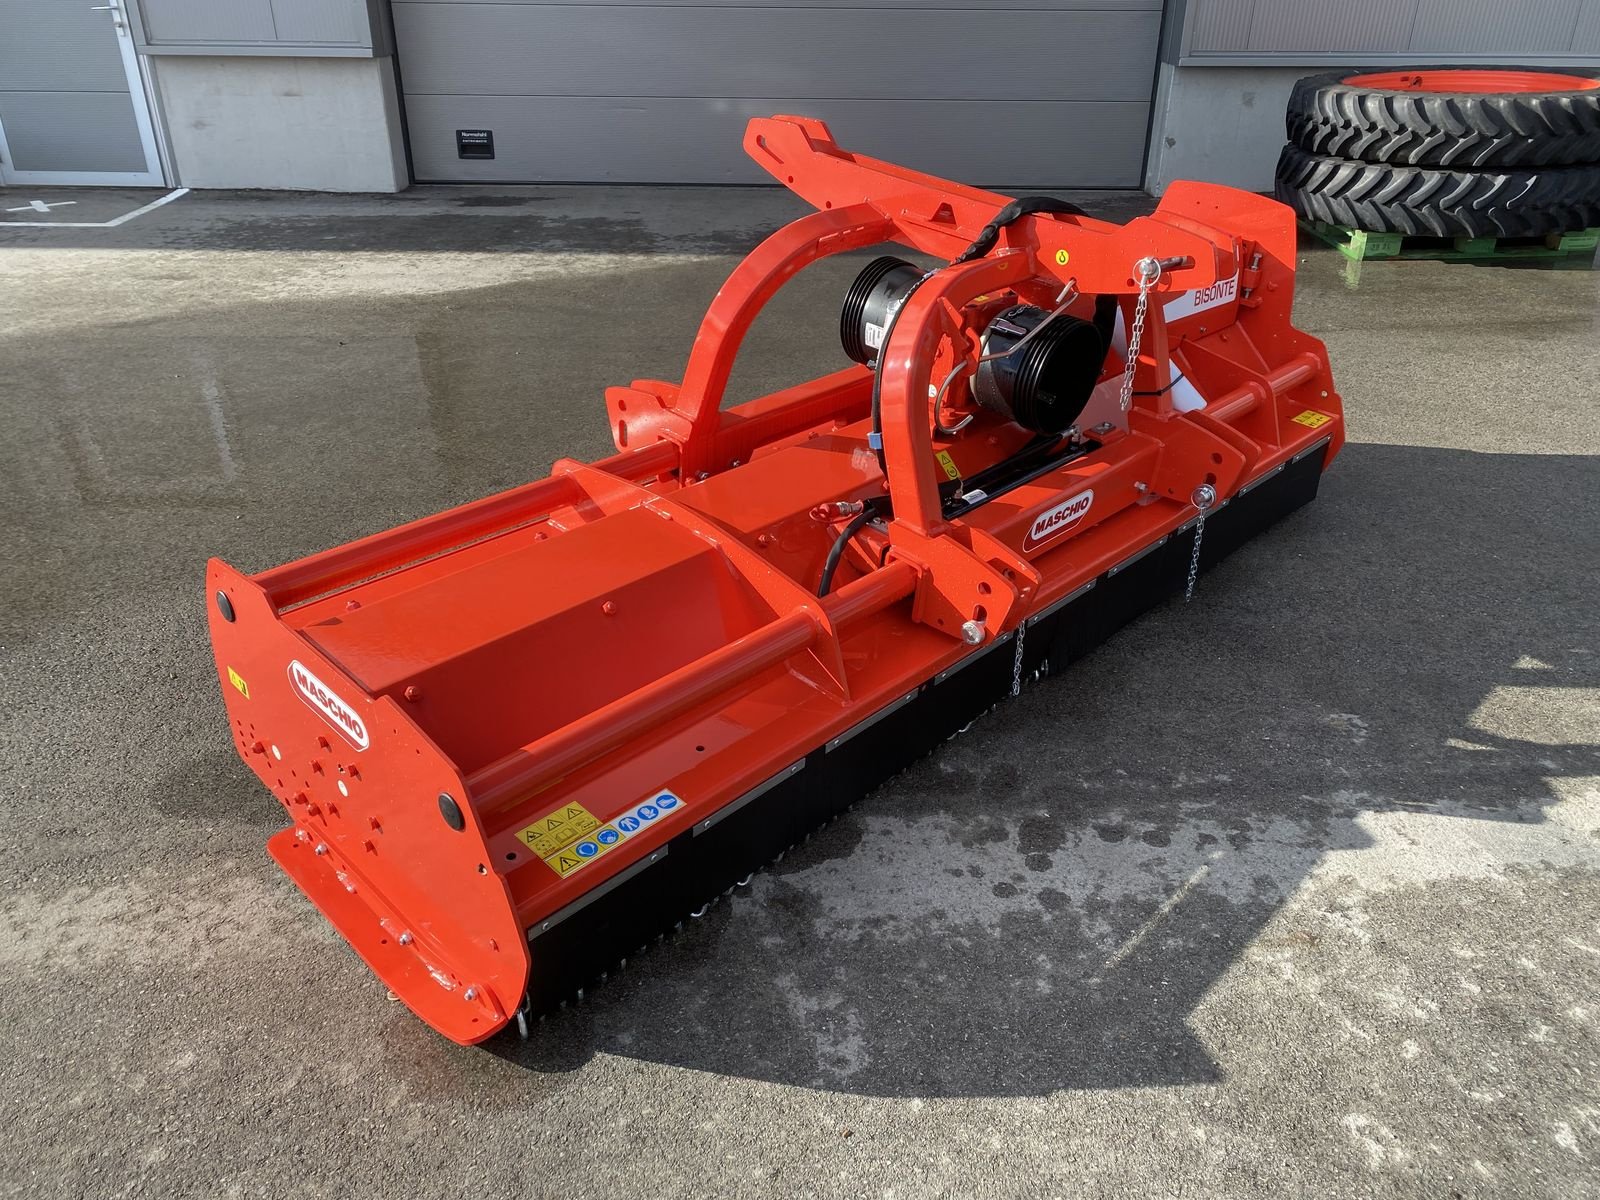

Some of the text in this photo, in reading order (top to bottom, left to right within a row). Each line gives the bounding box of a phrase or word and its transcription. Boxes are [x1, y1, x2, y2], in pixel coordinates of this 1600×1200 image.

[1194, 279, 1235, 307] BISONTE
[1033, 496, 1090, 536] MASCHIO
[295, 668, 364, 740] MASCHIO
